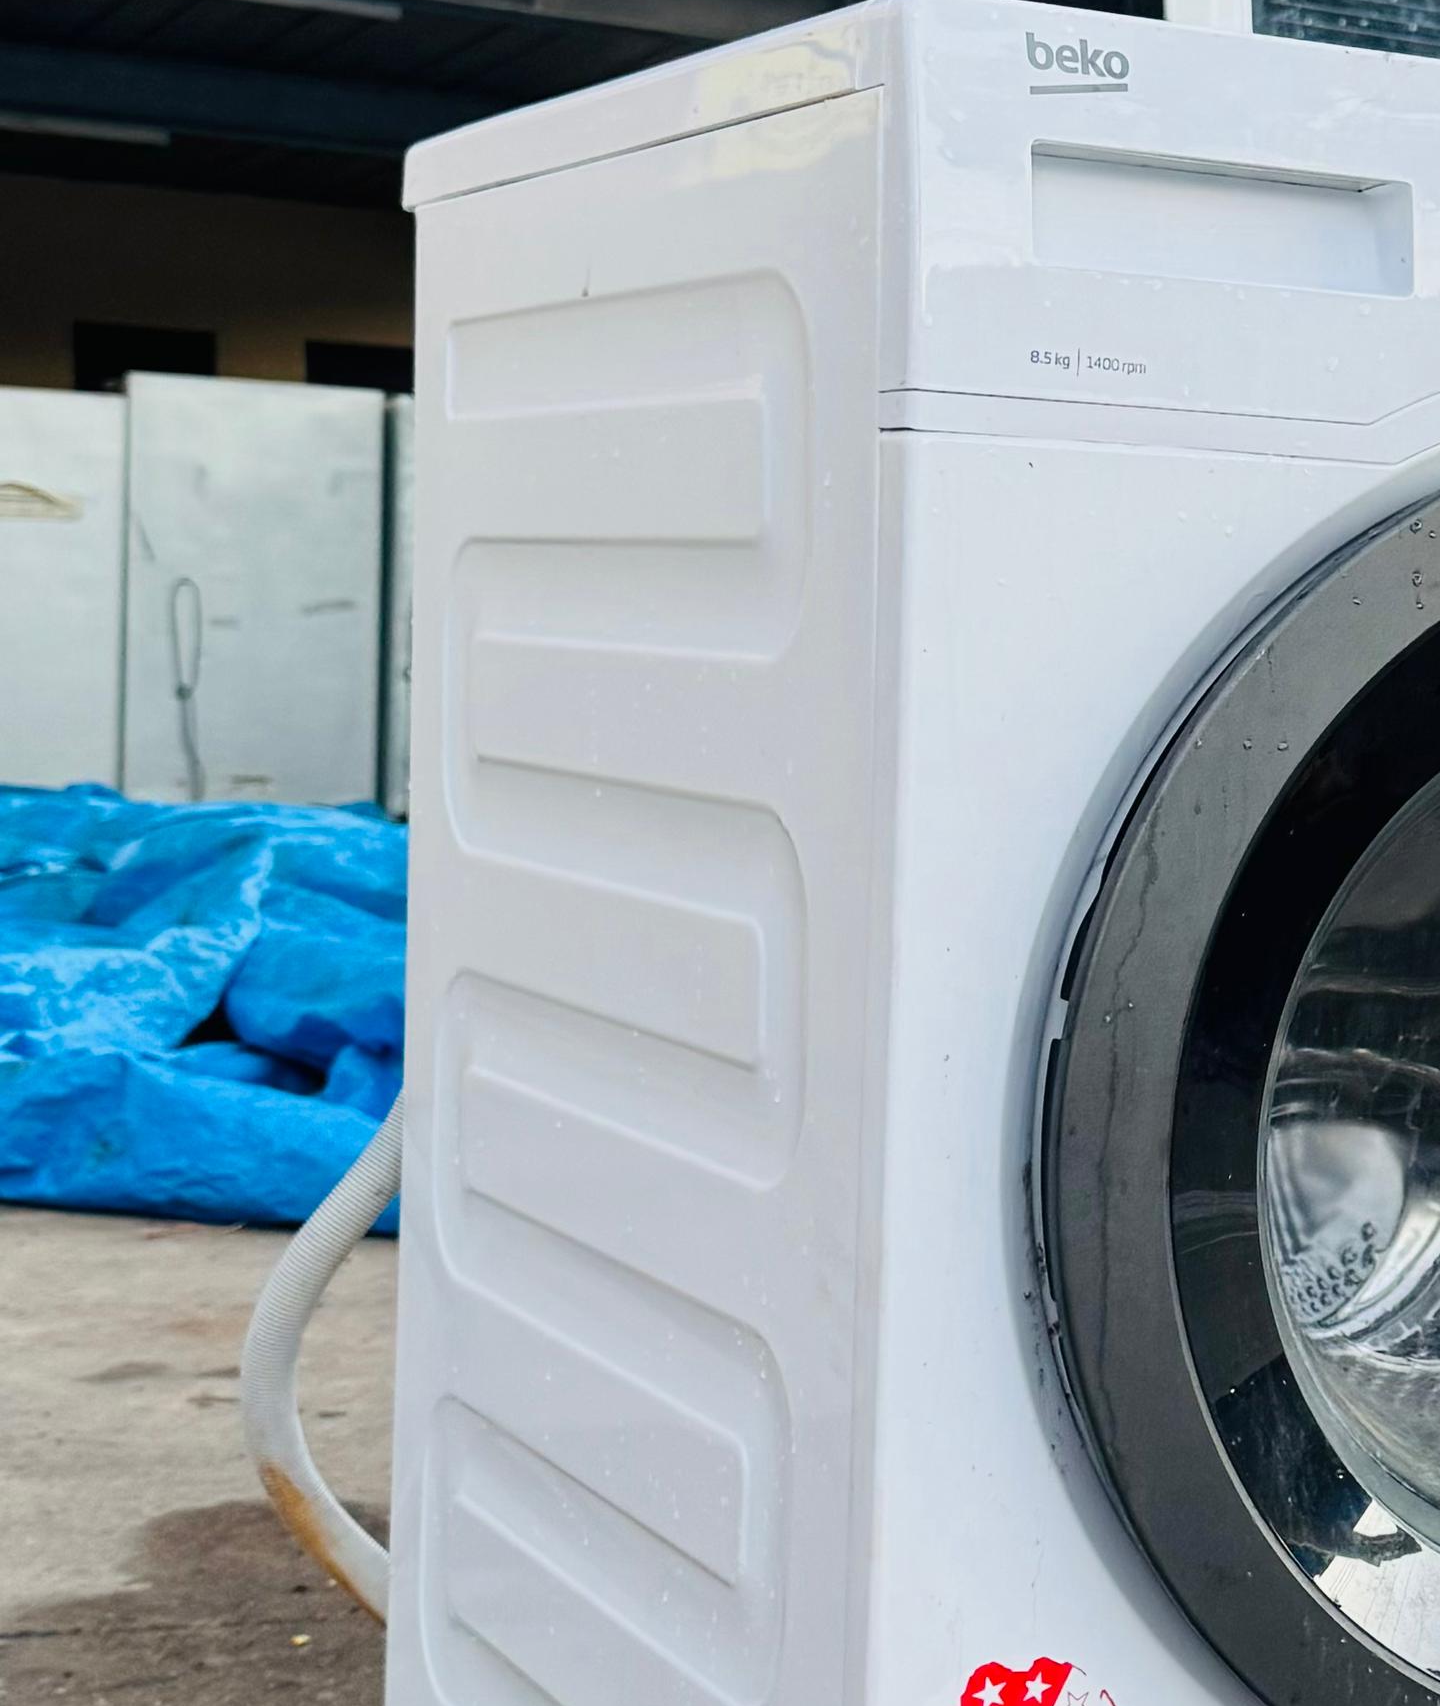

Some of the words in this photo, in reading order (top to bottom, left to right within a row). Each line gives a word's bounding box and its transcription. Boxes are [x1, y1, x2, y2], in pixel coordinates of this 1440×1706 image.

[1026, 32, 1130, 80] beko
[1030, 350, 1053, 364] 8.5
[1054, 352, 1071, 369] kg
[1086, 356, 1121, 371] 1400
[1121, 362, 1147, 375] rpm
